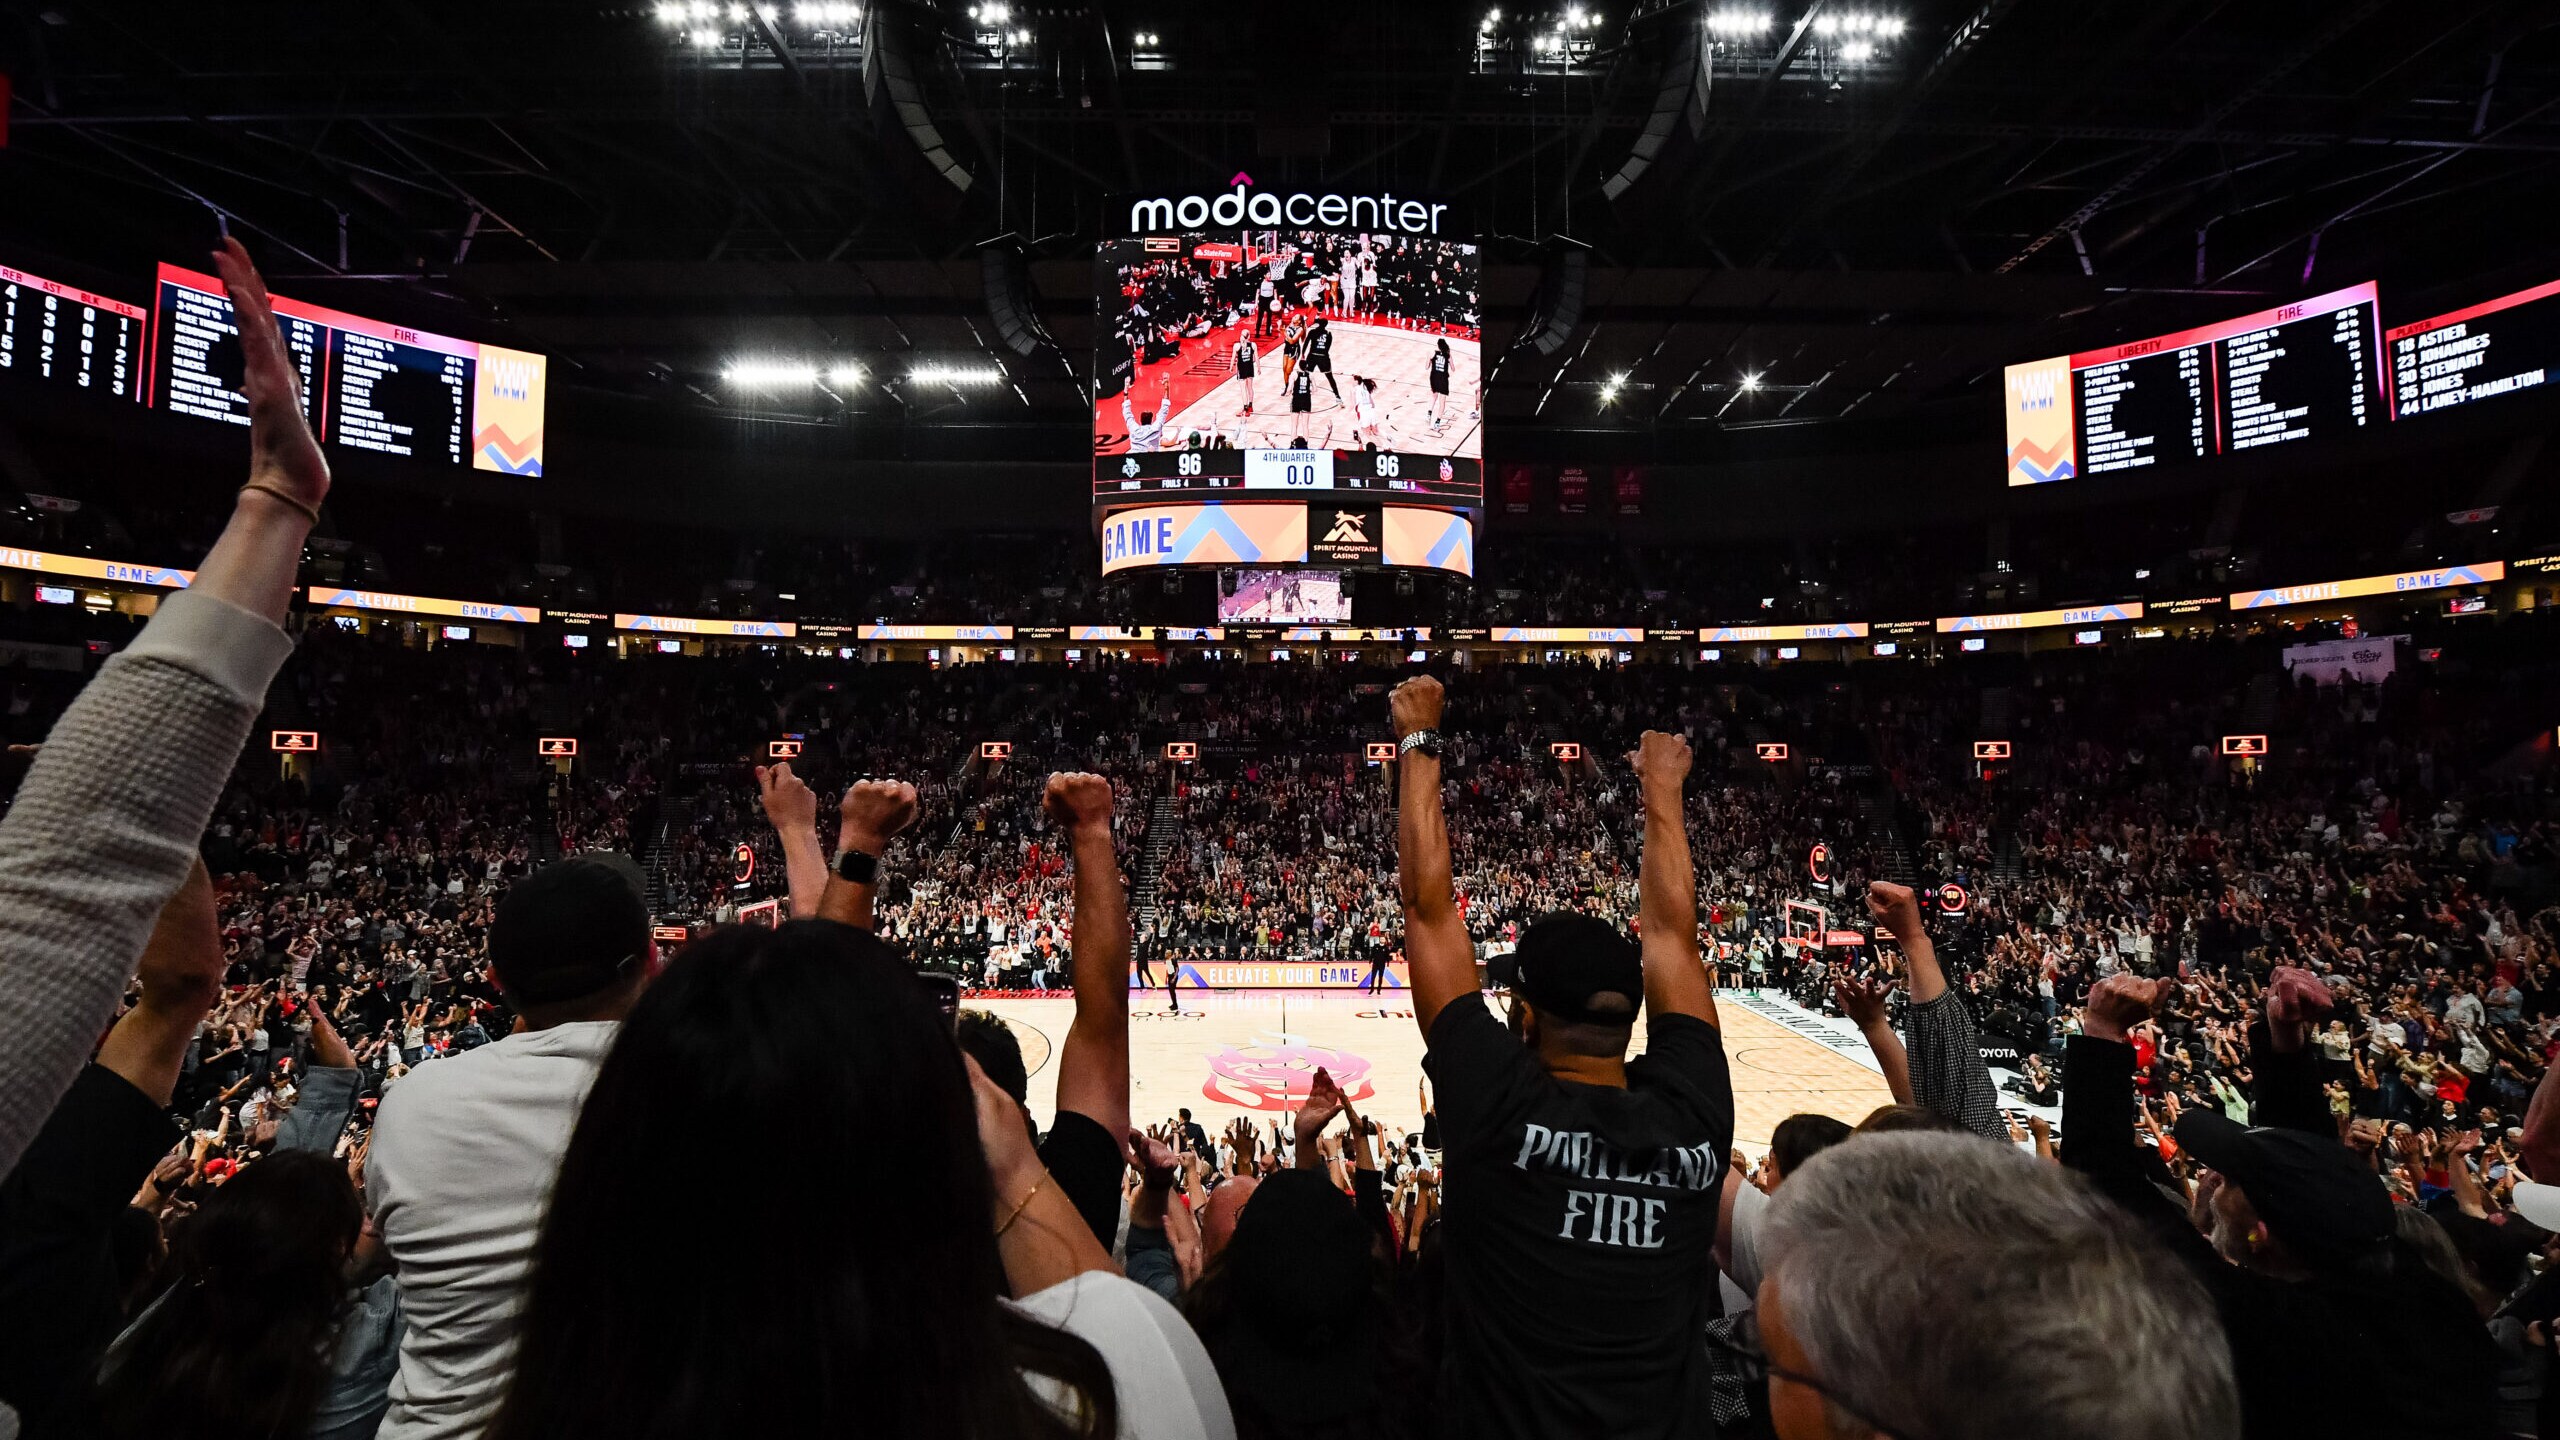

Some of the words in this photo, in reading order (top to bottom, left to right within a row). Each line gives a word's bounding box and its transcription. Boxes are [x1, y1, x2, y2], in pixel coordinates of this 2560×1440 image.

[2, 269, 22, 282] REB
[42, 282, 62, 294] AST
[80, 293, 100, 306] BLK
[115, 303, 133, 316] FLS
[5, 284, 18, 299] 4
[45, 296, 57, 310] 6
[84, 307, 95, 322] 0
[120, 318, 128, 332] 1
[2278, 305, 2304, 321] FIRE
[6, 301, 15, 316] 1
[44, 312, 56, 327] 3
[82, 323, 94, 338] 0
[118, 334, 126, 348] 1
[2396, 322, 2431, 338] PLAYER
[5, 318, 14, 333] 1
[42, 329, 54, 344] 0
[80, 340, 92, 354] 0
[115, 348, 126, 364] 2
[394, 328, 418, 344] FIRE
[2397, 338, 2415, 354] 18
[2418, 323, 2467, 349] ASTIER
[1, 334, 13, 350] 5
[41, 346, 53, 361] 2
[82, 356, 90, 370] 1
[114, 364, 126, 379] 3
[2118, 340, 2162, 358] LIBERTY
[2397, 354, 2416, 370] 23
[2419, 333, 2490, 364] JOHANNES
[0, 352, 12, 367] 3
[42, 363, 50, 378] 1
[78, 372, 90, 387] 3
[112, 380, 124, 395] 3
[2398, 369, 2418, 386] 30
[2420, 350, 2486, 380] STEWART
[2399, 384, 2418, 400] 35
[2422, 373, 2464, 396] JONES
[2400, 400, 2420, 416] 44
[2422, 368, 2545, 412] LANEY-HAMILTON
[1178, 453, 1202, 475] 96
[1263, 453, 1278, 462] 4TH
[1280, 453, 1316, 462] QUARTER
[1376, 454, 1400, 477] 96
[1162, 479, 1182, 488] FOULS
[1184, 478, 1190, 488] 4
[1208, 478, 1221, 487] TOL
[1287, 465, 1314, 485] 0.0
[1350, 478, 1362, 488] TOL
[1365, 479, 1369, 488] 1
[1121, 481, 1142, 490] BONUS
[1388, 480, 1408, 490] FOULS
[1104, 517, 1173, 564] GAME
[1314, 544, 1336, 552] SPIRIT
[1337, 545, 1378, 553] MOUNTAIN
[1332, 552, 1360, 560] CASINO
[2514, 557, 2548, 568] SPIRIT
[0, 550, 42, 568] VATE
[106, 565, 154, 583] GAME
[2274, 584, 2339, 604] ELEVATE
[2396, 573, 2442, 590] GAME
[356, 592, 416, 610] ELEVATE
[462, 604, 497, 618] GAME
[2175, 597, 2222, 606] MOUNTAIN
[546, 610, 568, 618] SPIRIT
[570, 612, 608, 620] MOUNTAIN
[2170, 606, 2200, 614] CASINO
[650, 617, 697, 632] ELEVATE
[733, 624, 761, 634] GAME
[1894, 620, 1930, 628] MOUNTAIN
[1972, 615, 2022, 629] ELEVATE
[2064, 610, 2098, 622] GAME
[886, 627, 926, 638] ELEVATE
[956, 628, 982, 638] GAME
[1168, 630, 1194, 639] GAME
[1520, 630, 1558, 640] ELEVATE
[1588, 631, 1612, 640] GAME
[1730, 626, 1772, 639] ELEVATE
[1805, 628, 1832, 638] GAME
[1209, 968, 1269, 983] ELEVATE
[1276, 968, 1314, 983] YOUR
[1320, 968, 1358, 983] GAME
[1131, 1010, 1206, 1018] oda
[1979, 1048, 2018, 1058] OYOTA
[1512, 1124, 1718, 1191] PORTLAND
[1558, 1189, 1666, 1248] FIRE
